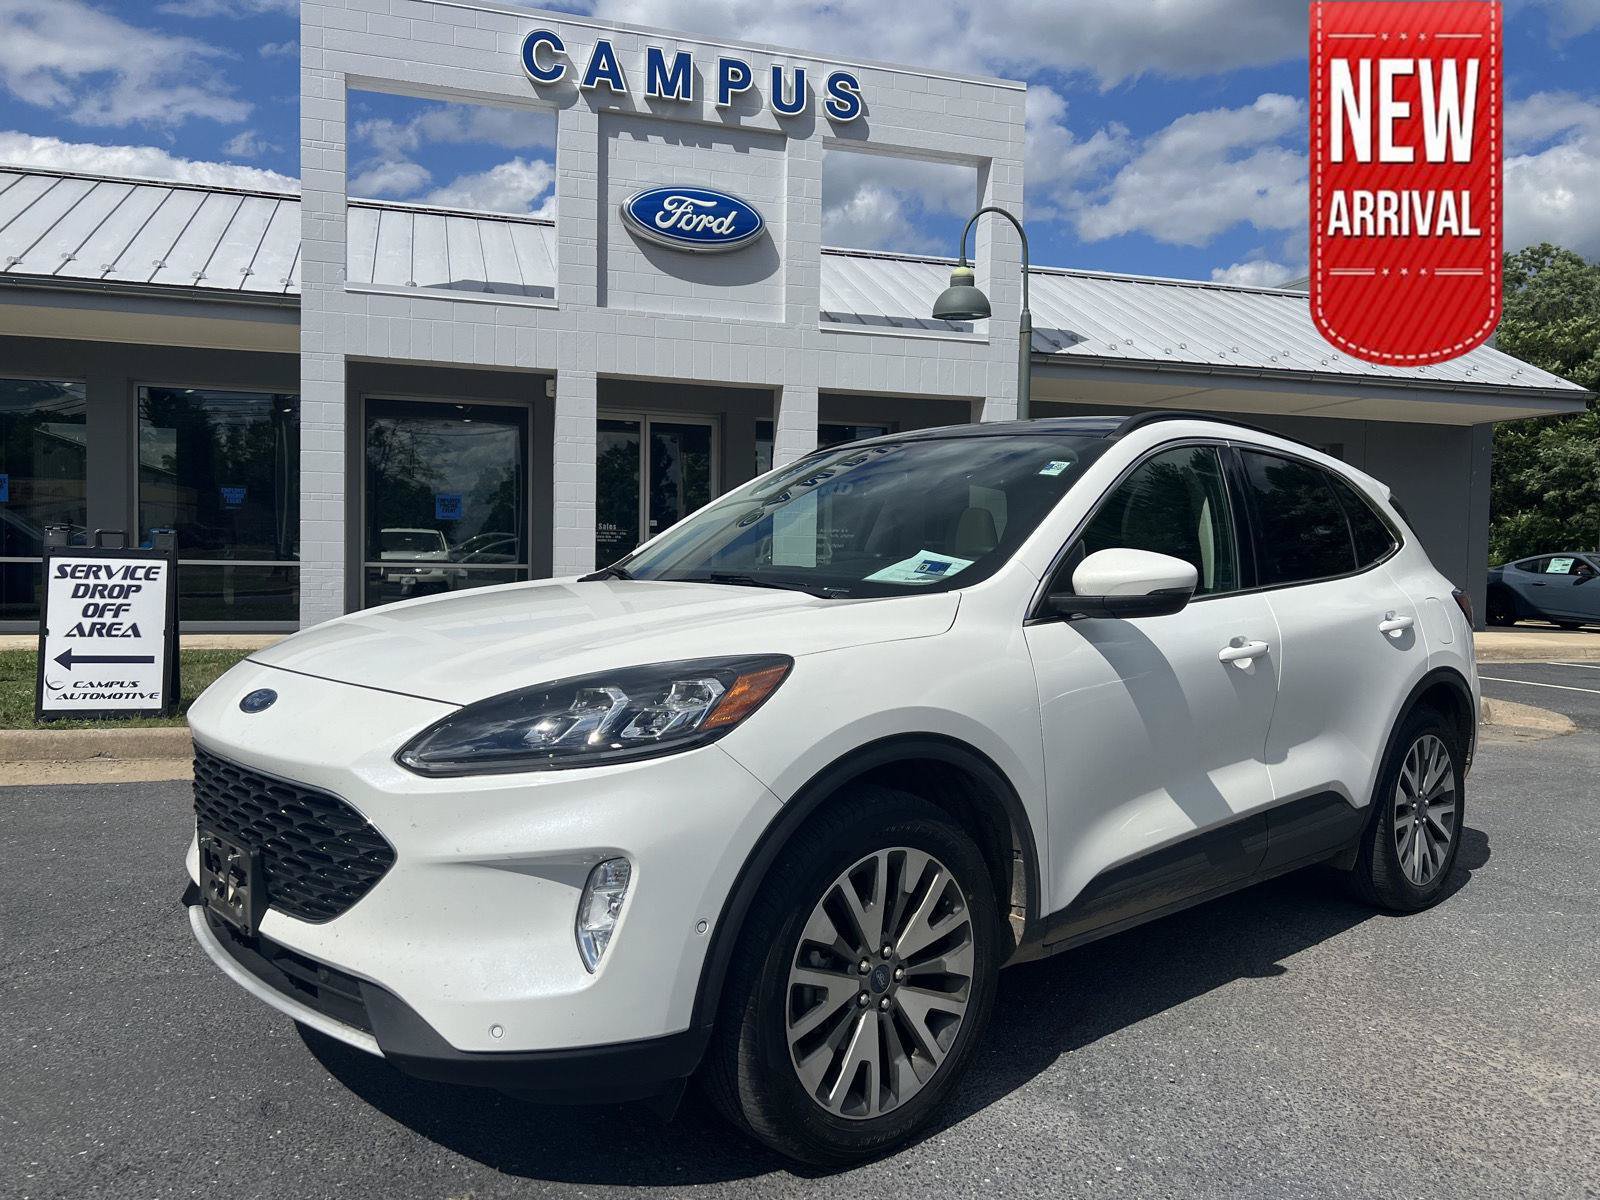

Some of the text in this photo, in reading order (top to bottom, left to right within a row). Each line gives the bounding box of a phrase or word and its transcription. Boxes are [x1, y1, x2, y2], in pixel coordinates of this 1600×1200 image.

[521, 29, 862, 122] CAMPUS
[655, 195, 739, 237] Ford
[598, 522, 617, 531] Sales
[54, 563, 162, 581] SERVICE
[71, 583, 143, 600] DROP
[81, 602, 132, 619] OFF
[64, 621, 142, 638] AREA
[72, 680, 141, 689] CAMPUS
[55, 691, 160, 701] AUTOMOTIVE
